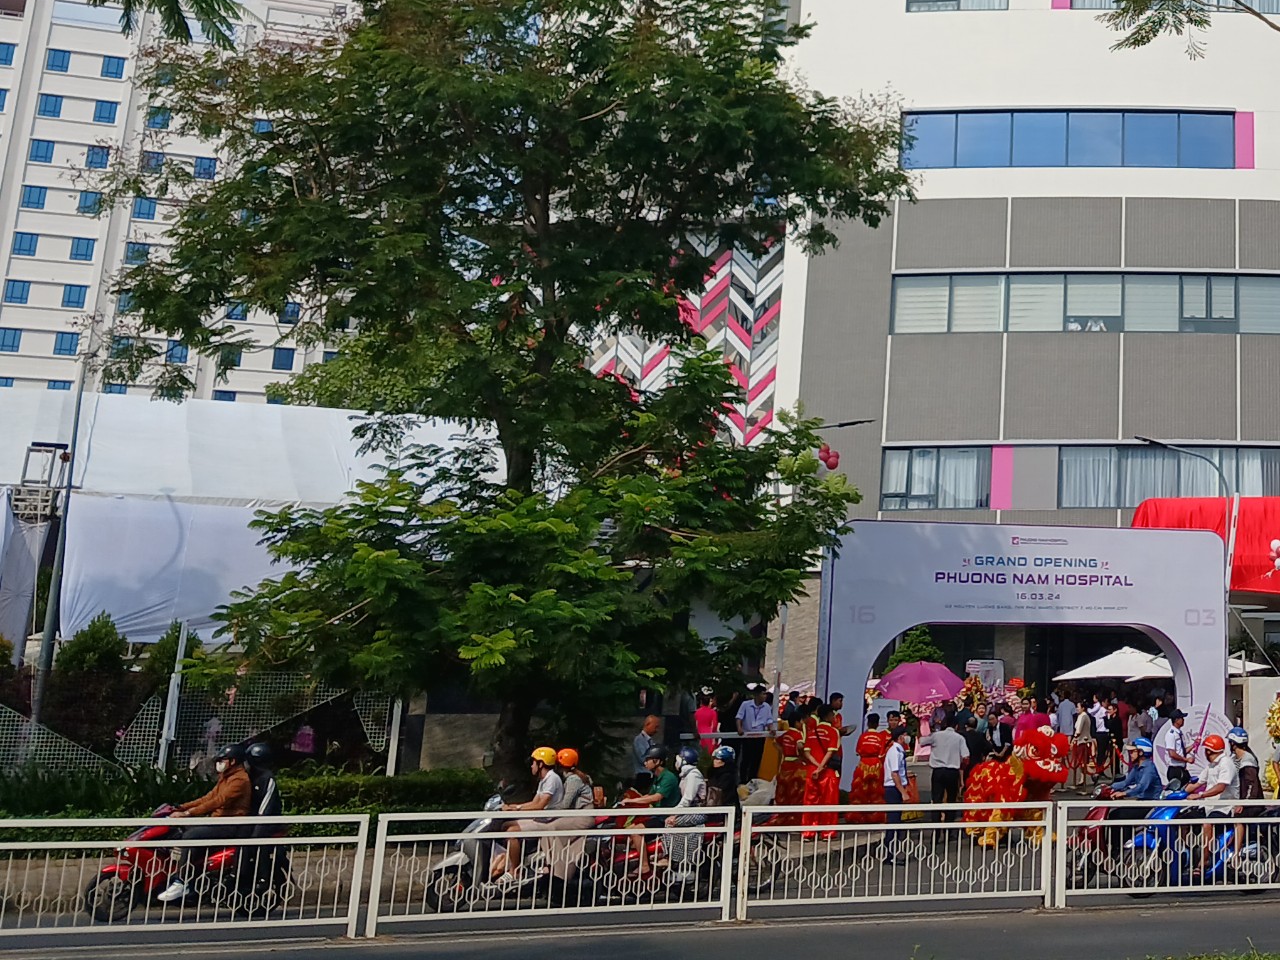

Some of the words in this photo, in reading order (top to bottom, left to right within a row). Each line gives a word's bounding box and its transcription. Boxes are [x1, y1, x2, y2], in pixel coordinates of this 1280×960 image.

[974, 555, 1028, 567] GRAND
[1033, 557, 1098, 568] OPENING
[934, 571, 1007, 584] PHUONG
[1012, 573, 1050, 586] NAM
[1054, 574, 1134, 587] HOSPITAL
[1016, 592, 1060, 601] 16.03.24
[849, 605, 876, 624] 16
[1185, 609, 1216, 626] 03
